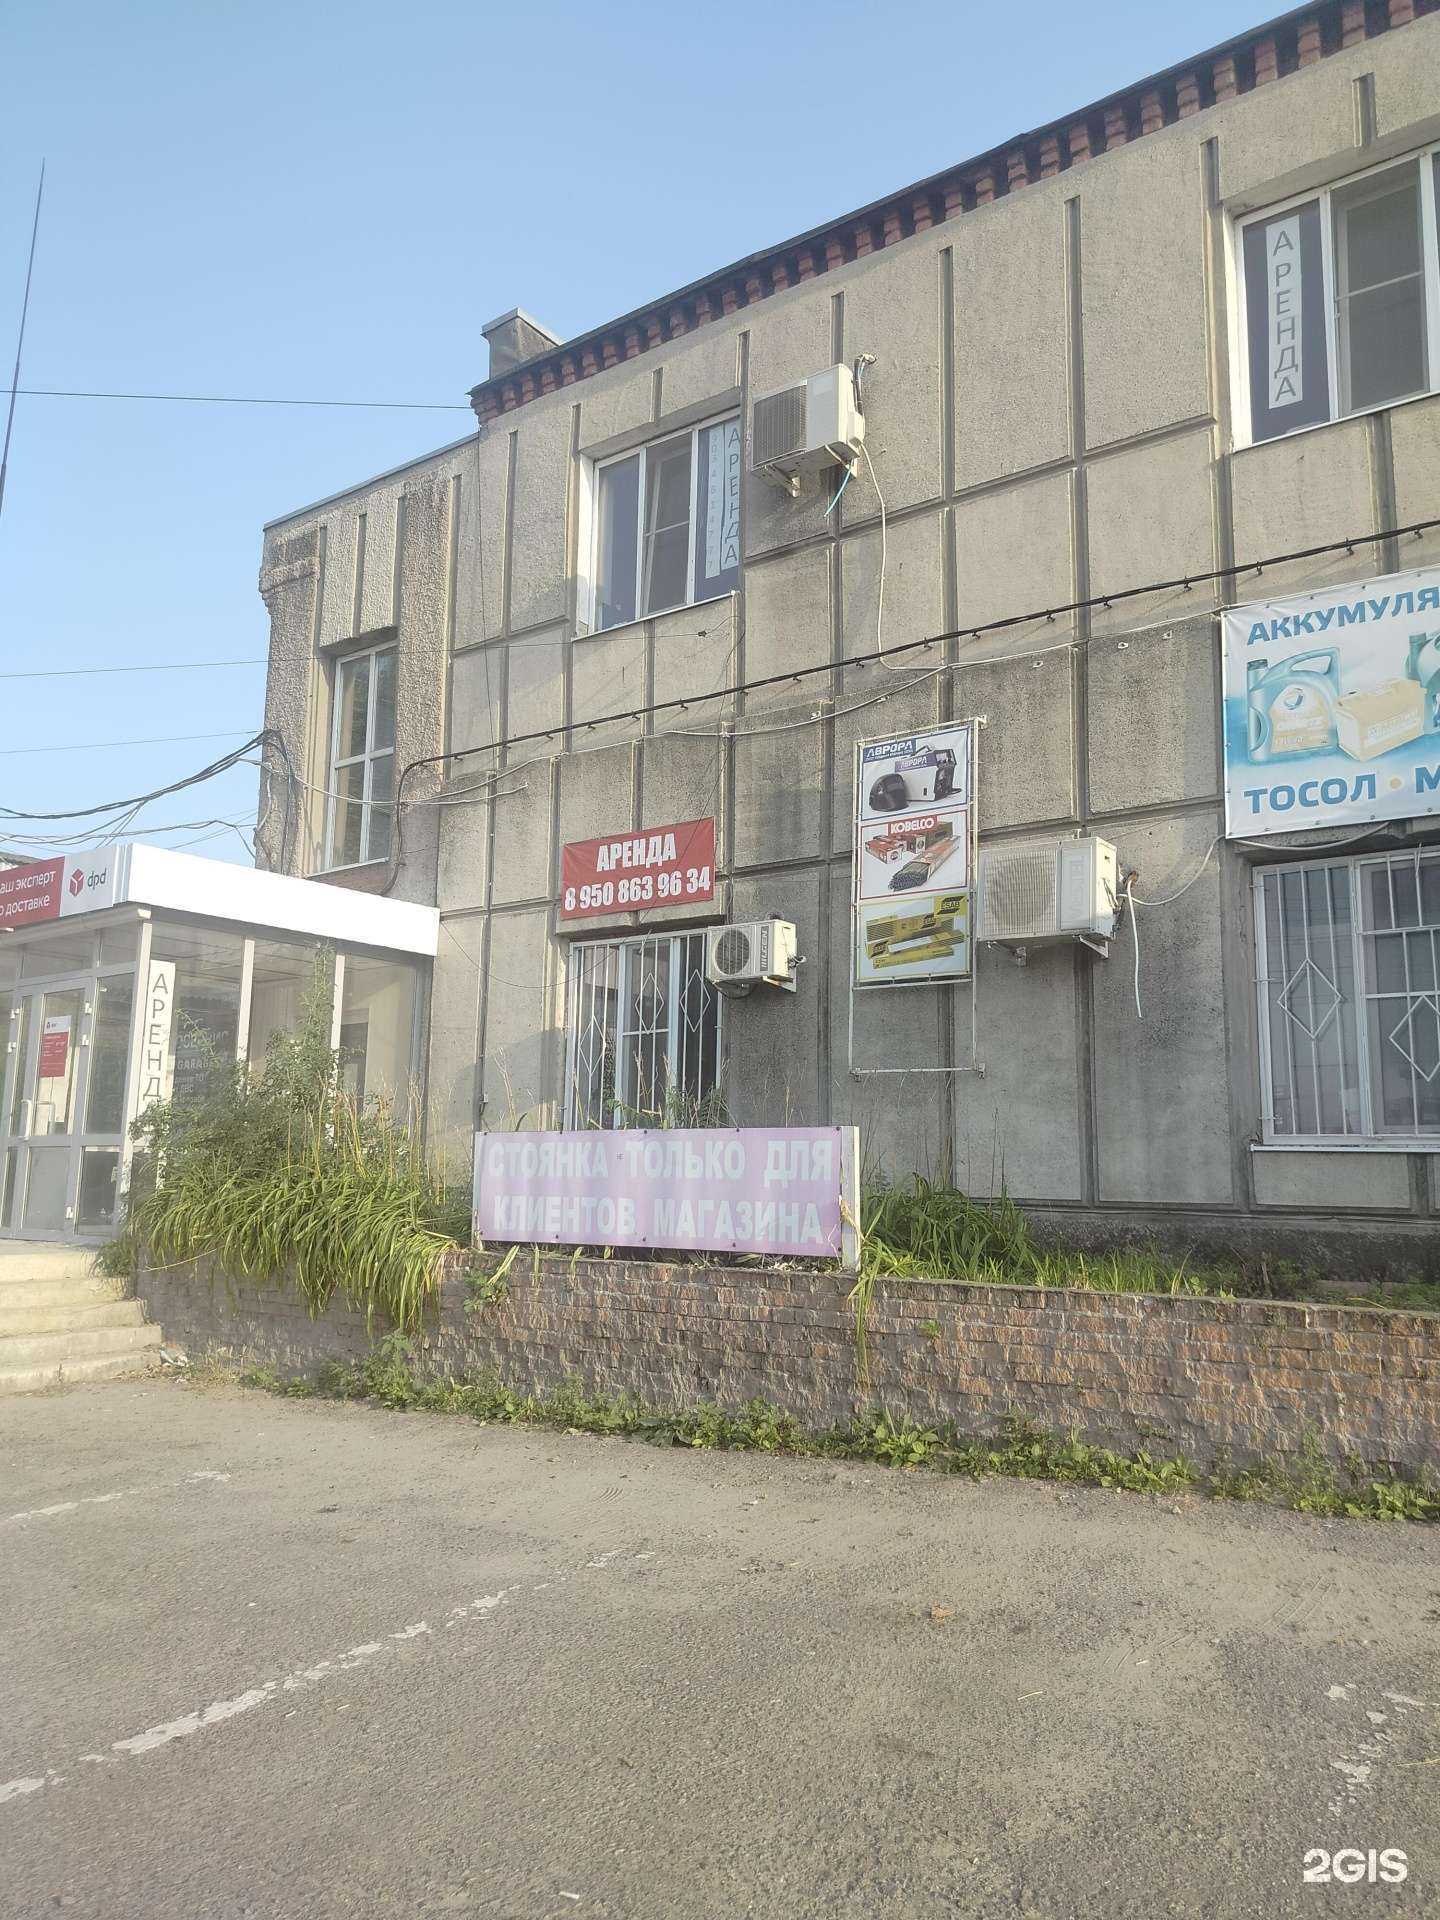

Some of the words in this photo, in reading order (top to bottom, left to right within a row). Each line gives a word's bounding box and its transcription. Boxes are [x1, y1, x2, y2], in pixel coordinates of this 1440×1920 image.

[1272, 230, 1299, 402] АРЕНДА
[1247, 587, 1440, 646] АККУМУЛЯ
[1244, 773, 1376, 814] ТОСОЛ
[890, 817, 934, 835] KOBELCO
[597, 833, 677, 872] АРЕНДА
[15, 871, 56, 891] эксперт
[87, 868, 107, 890] dpd
[564, 887, 576, 911] 8
[579, 882, 614, 909] 950
[618, 875, 653, 903] 863
[657, 871, 682, 898] 96
[686, 866, 711, 894] 34
[5, 895, 50, 918] доставке
[143, 973, 169, 1103] АРЕНД
[488, 1141, 609, 1178] СТОЯНКА
[624, 1140, 746, 1180] ТОЛЬКО
[763, 1140, 833, 1188] ДЛЯ
[494, 1195, 635, 1234] КЛИЕНТОВ
[654, 1199, 824, 1244] МАГАЗИНА
